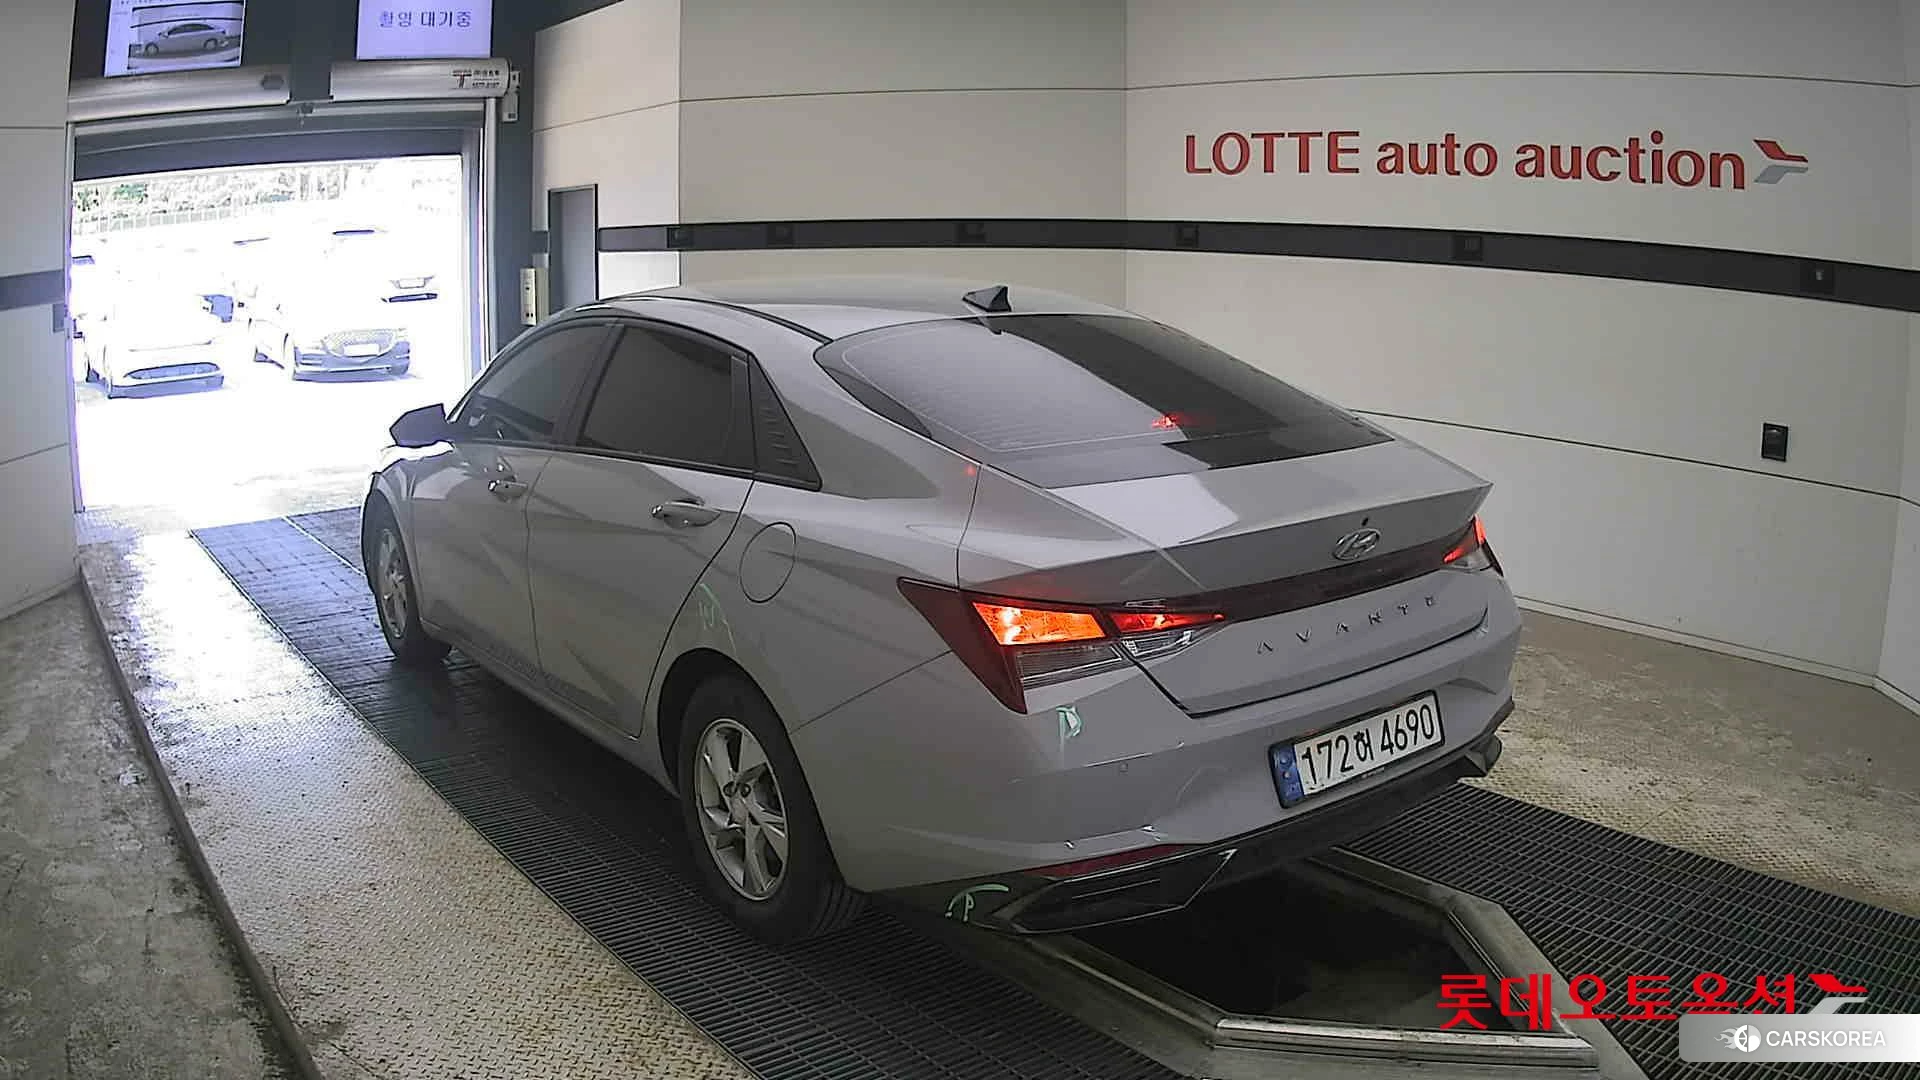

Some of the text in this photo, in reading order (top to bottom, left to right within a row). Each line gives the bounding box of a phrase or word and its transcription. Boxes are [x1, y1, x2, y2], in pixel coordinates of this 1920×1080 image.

[421, 10, 471, 28] 대기중
[1185, 130, 1745, 190] LOTTE auto auction
[1301, 703, 1435, 785] 172허 4690
